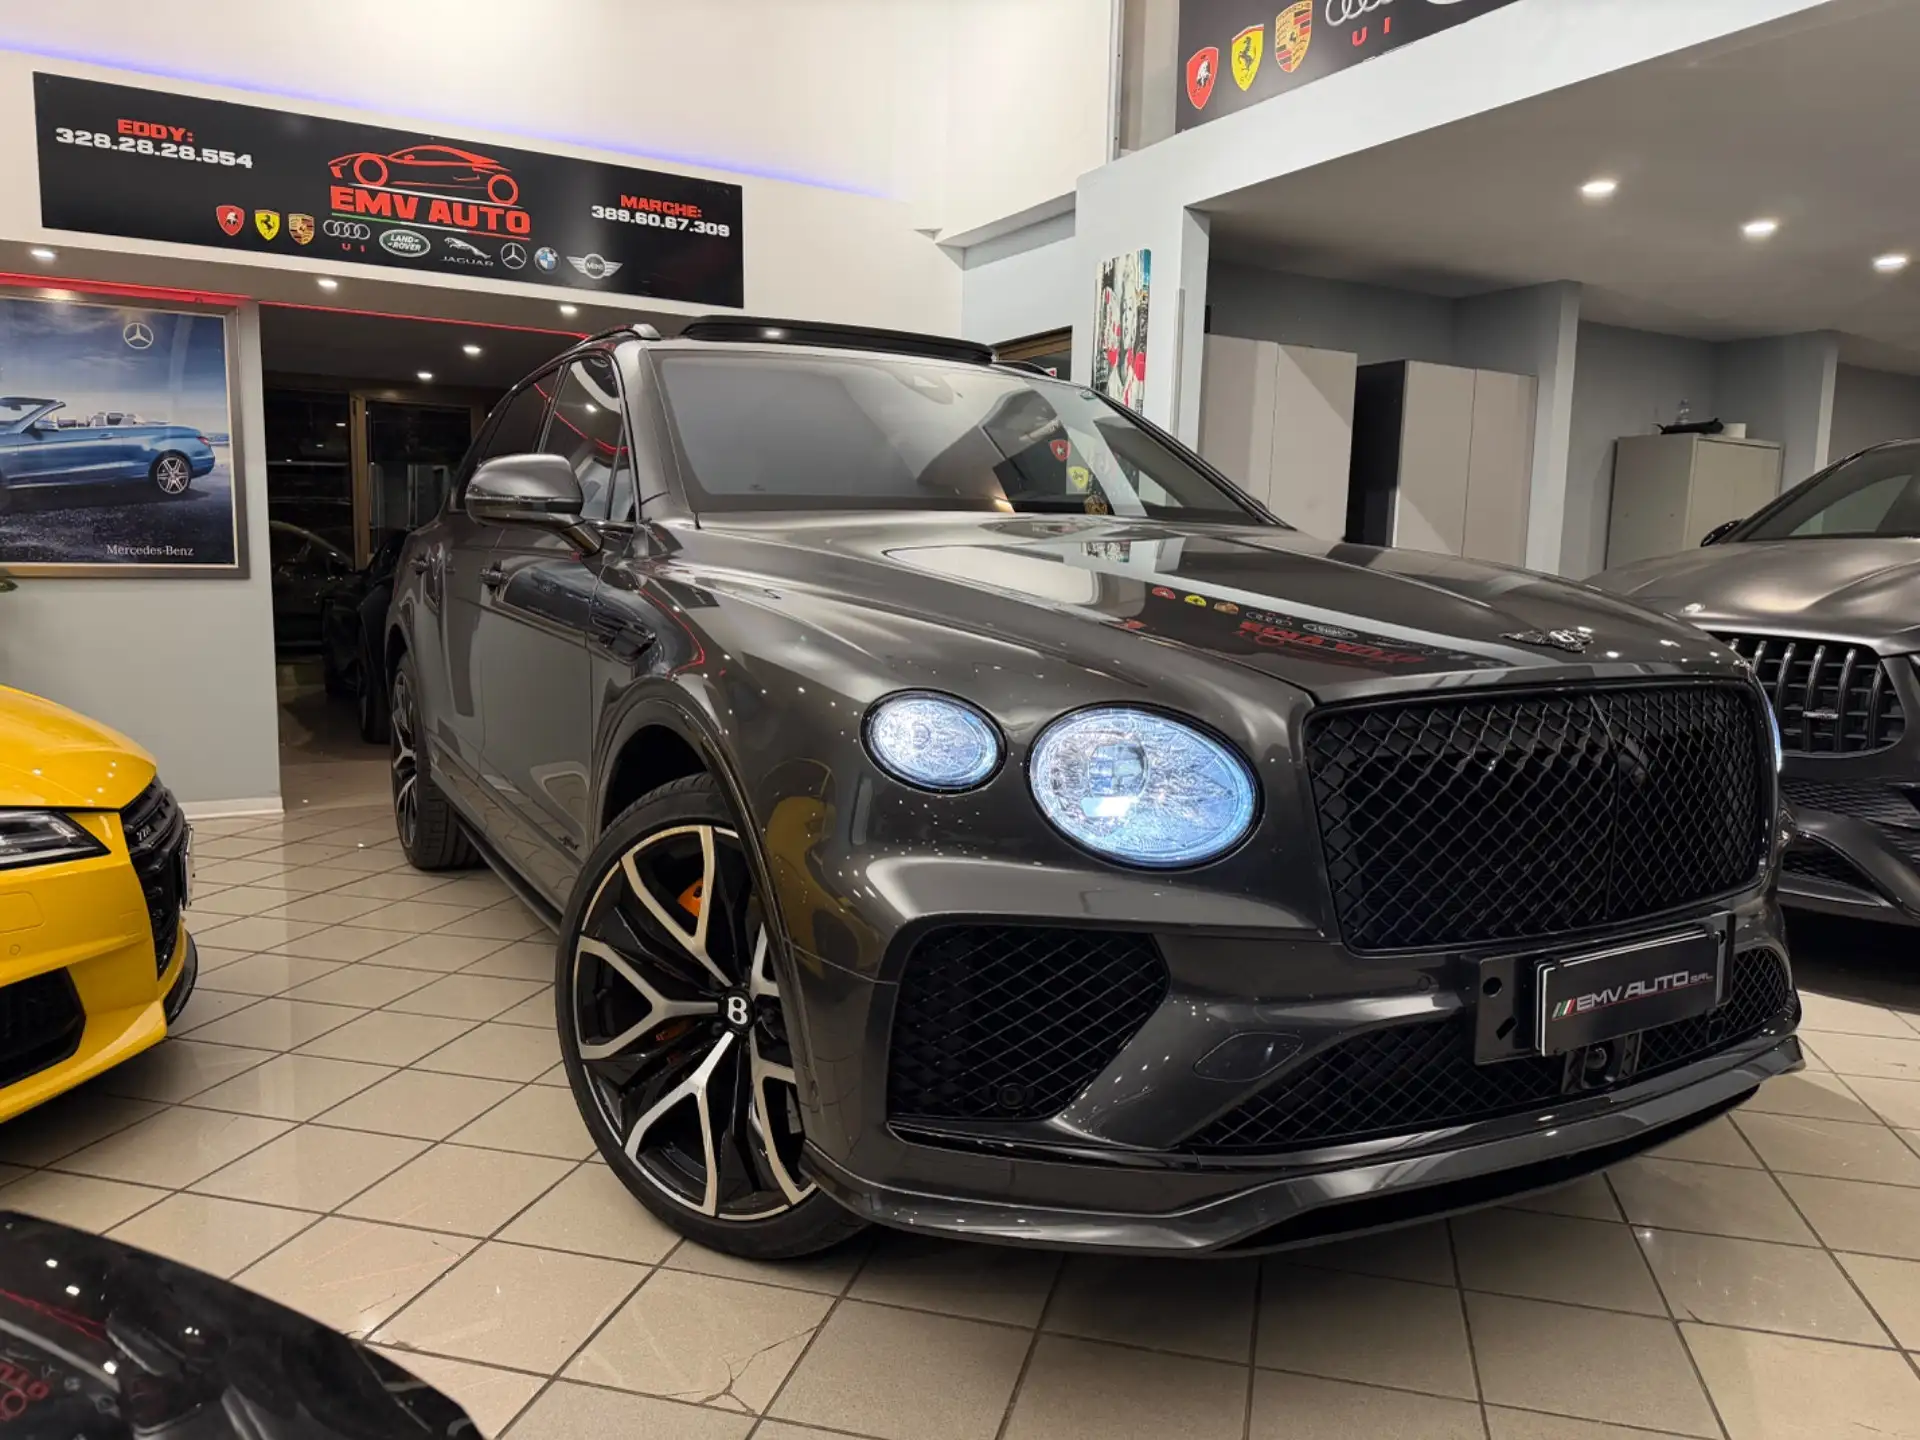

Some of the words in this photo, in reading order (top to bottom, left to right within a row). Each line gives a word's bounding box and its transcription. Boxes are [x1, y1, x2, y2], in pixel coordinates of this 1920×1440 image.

[117, 118, 195, 143] EDDY:
[55, 127, 253, 169] 328.28.28.554
[330, 185, 420, 221] EMV
[428, 199, 531, 234] AUTO
[620, 194, 703, 218] MARCHE:
[591, 205, 731, 238] 389.60.67.309
[390, 234, 415, 243] LAND
[392, 241, 422, 252] ROVER
[440, 255, 495, 267] JAGUAR
[106, 543, 195, 557] Mercedes-Benz
[1576, 986, 1623, 1012] EMV
[1624, 970, 1690, 999] AUTO
[727, 996, 748, 1025] B
